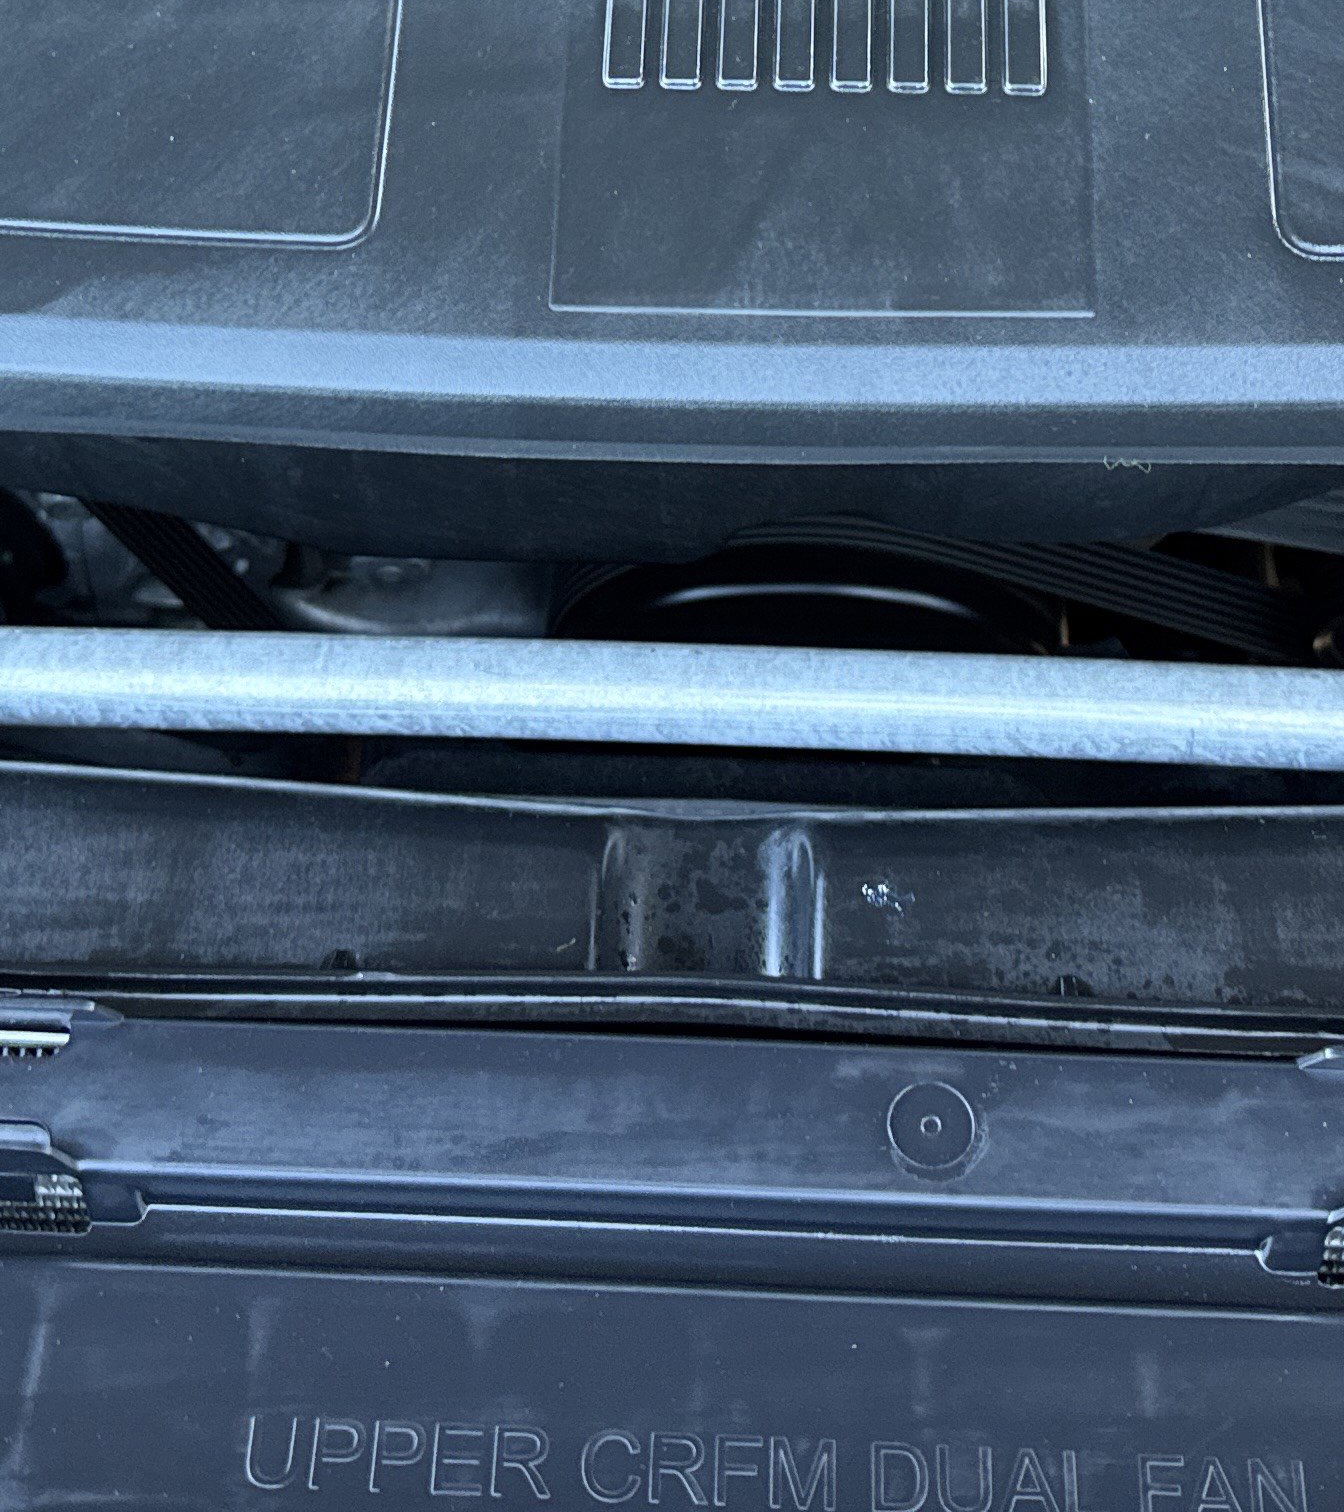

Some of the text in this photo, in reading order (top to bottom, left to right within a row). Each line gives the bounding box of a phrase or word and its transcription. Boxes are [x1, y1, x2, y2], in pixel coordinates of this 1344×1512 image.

[244, 1415, 552, 1499] UPPER
[580, 1428, 837, 1511] CRFM
[1137, 1453, 1308, 1512] FAN
